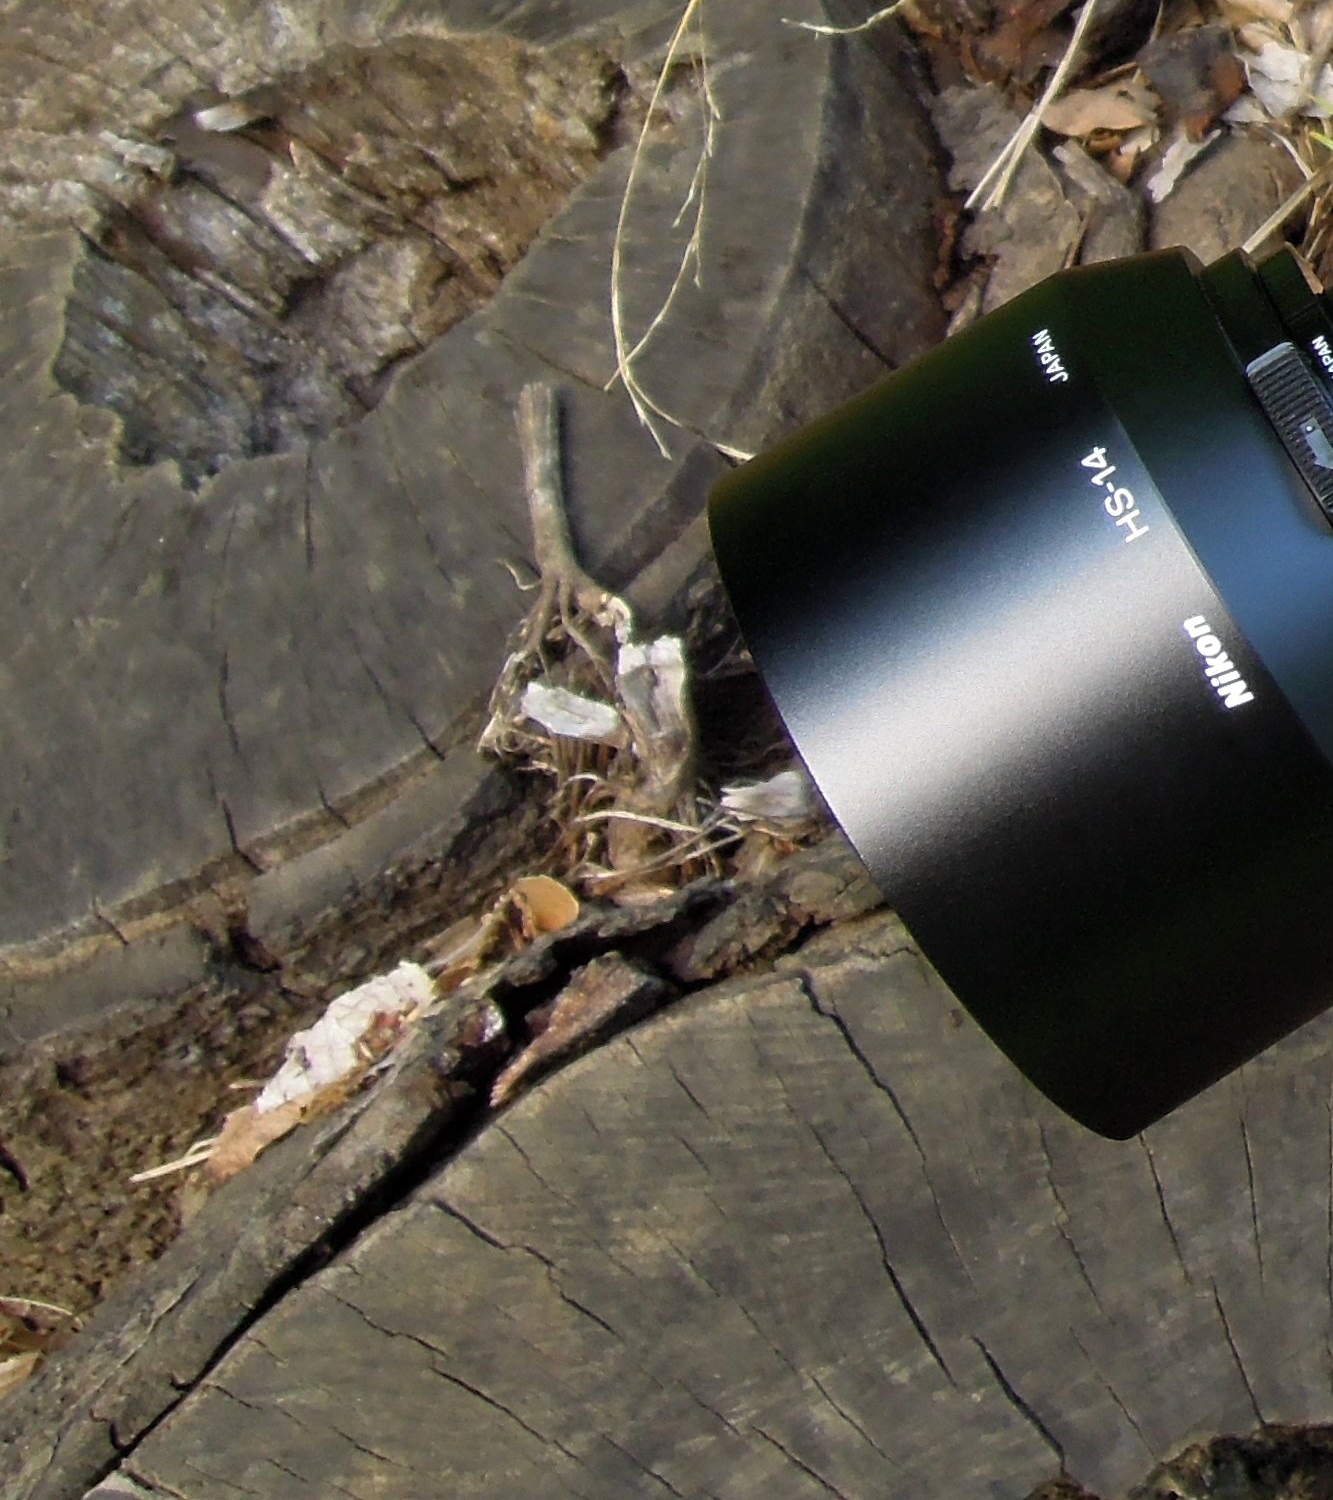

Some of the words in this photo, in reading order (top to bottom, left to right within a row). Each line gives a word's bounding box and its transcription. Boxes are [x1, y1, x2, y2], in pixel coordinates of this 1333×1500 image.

[1031, 328, 1070, 384] JAPAN
[1081, 445, 1150, 543] HS-14
[1182, 614, 1255, 710] Nikon
